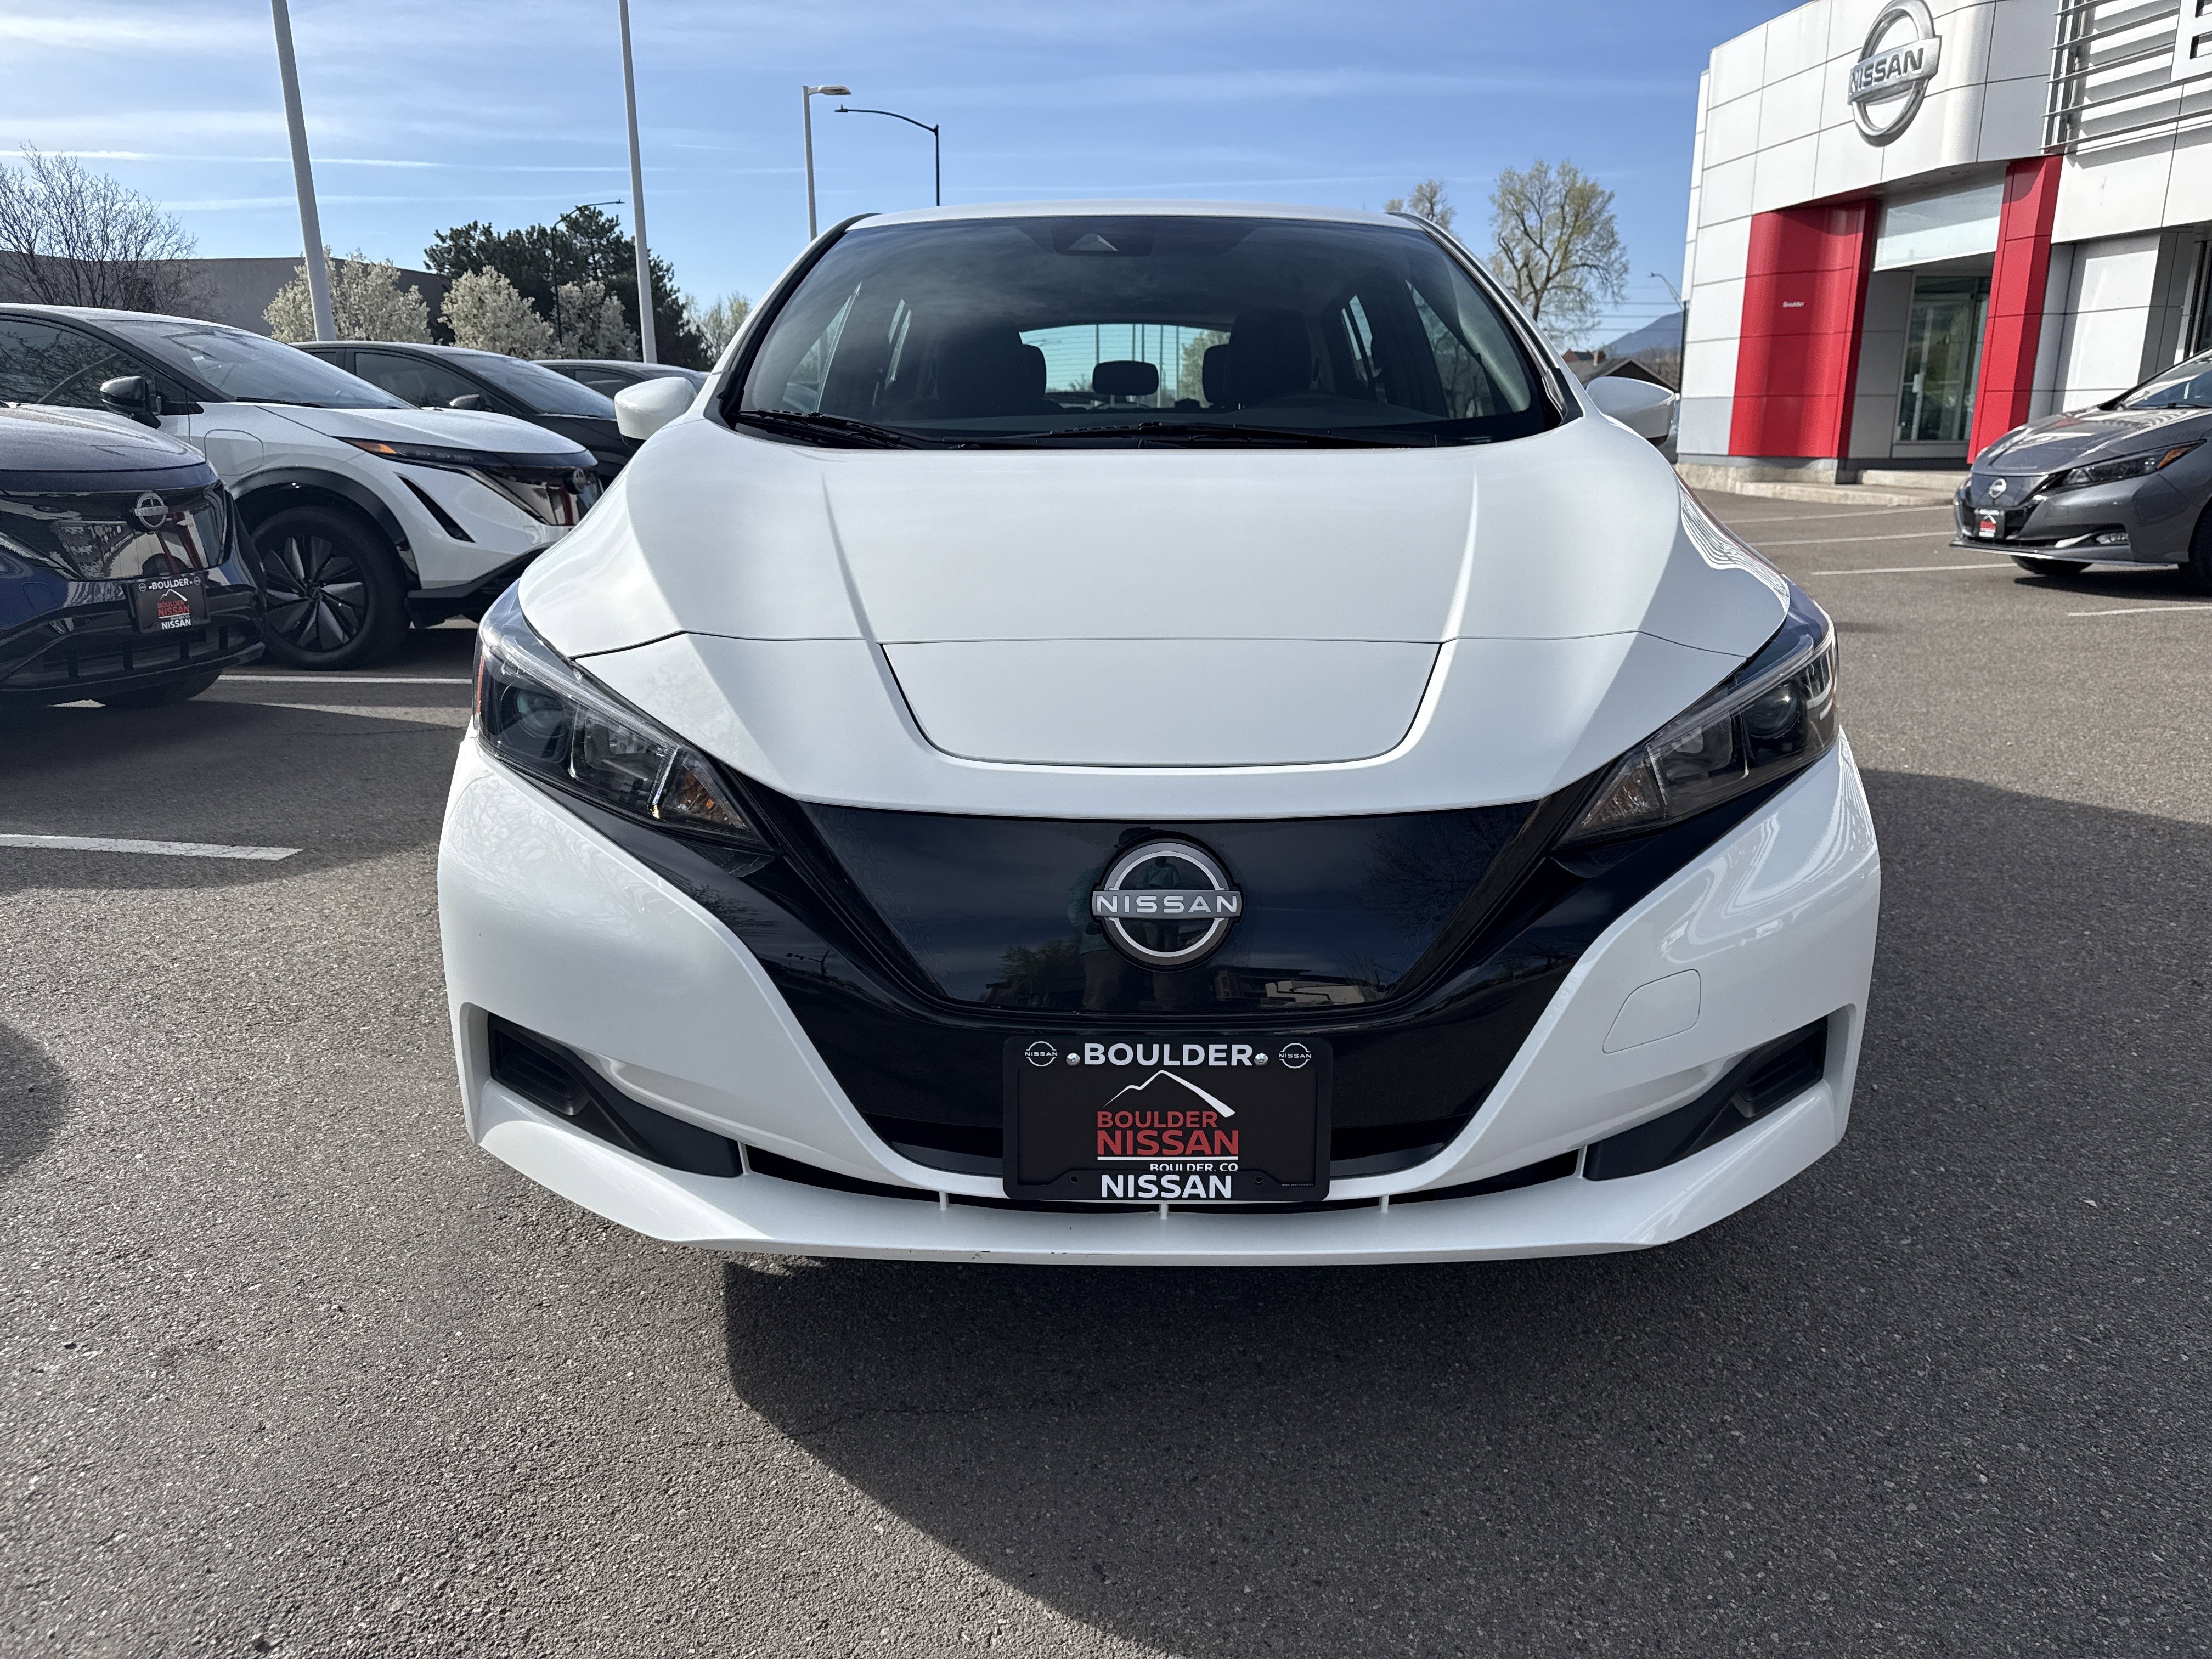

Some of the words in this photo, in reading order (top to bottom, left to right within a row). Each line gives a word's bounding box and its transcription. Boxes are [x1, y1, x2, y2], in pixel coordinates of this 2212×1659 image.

[1852, 48, 1923, 92] NISSAN
[151, 578, 189, 590] BOULDER
[157, 600, 185, 609] BOULDER
[157, 605, 190, 616] NISSAN
[161, 618, 191, 630] NISSAN
[1097, 895, 1237, 913] NISSAN
[1084, 1043, 1252, 1066] BOULDER
[1097, 1111, 1218, 1128] BOULDER
[1097, 1130, 1239, 1155] NISSAN
[1220, 1163, 1238, 1171] CO
[1101, 1174, 1232, 1198] NISSAN
